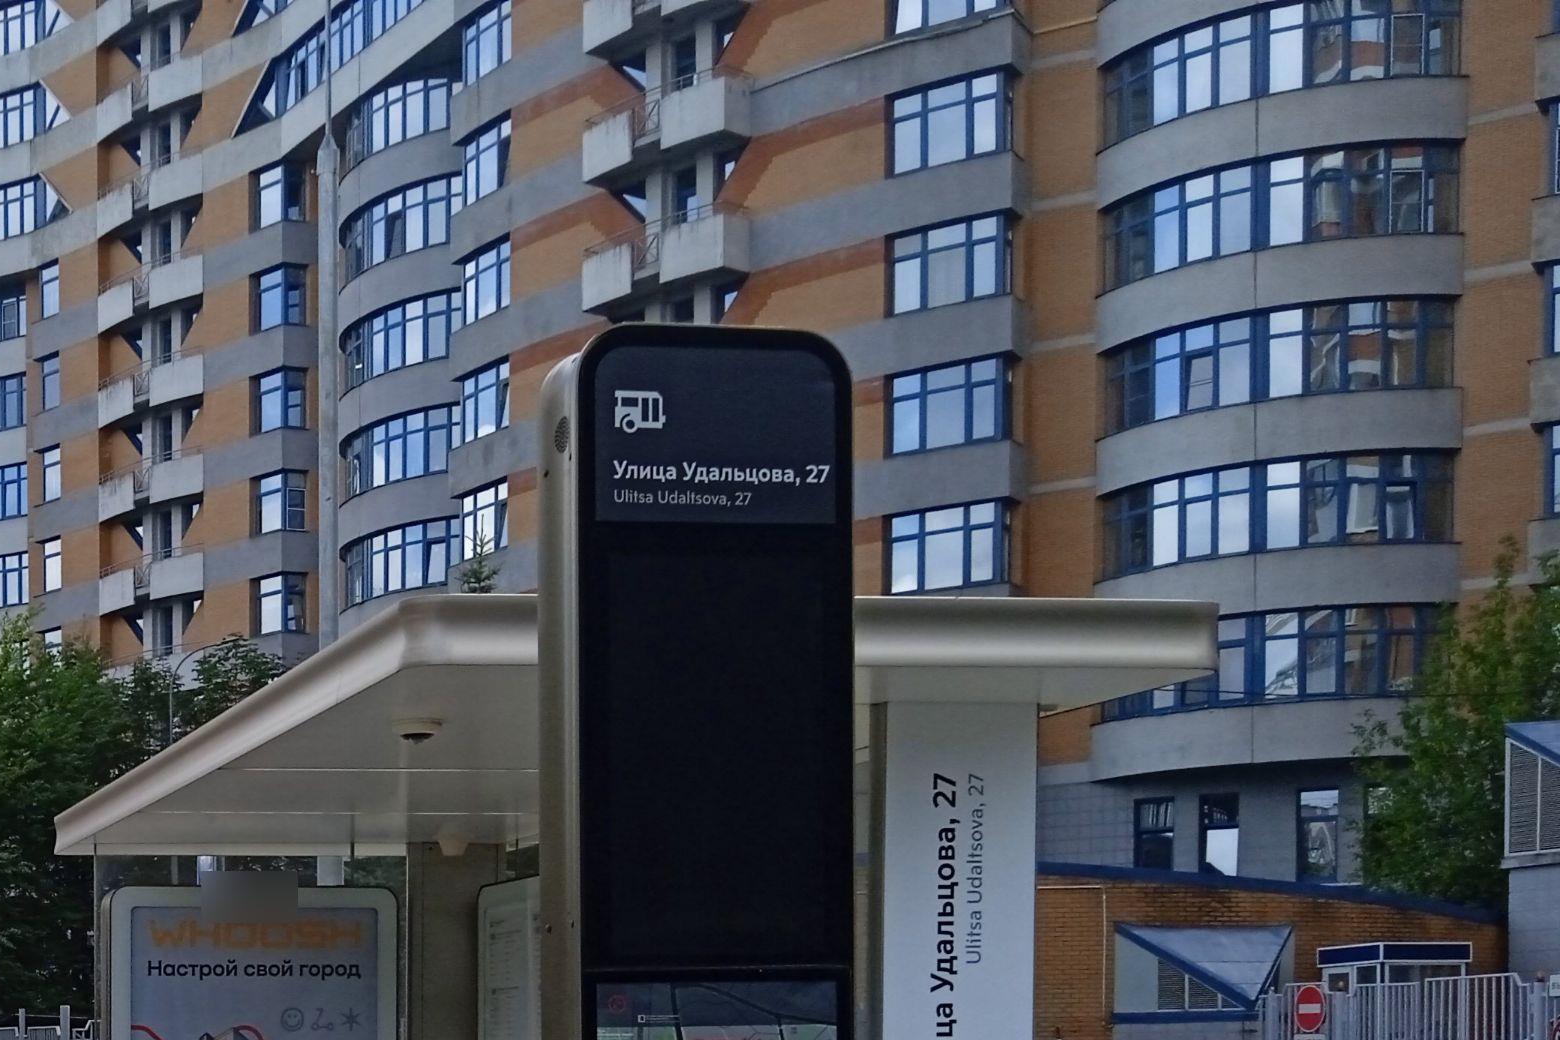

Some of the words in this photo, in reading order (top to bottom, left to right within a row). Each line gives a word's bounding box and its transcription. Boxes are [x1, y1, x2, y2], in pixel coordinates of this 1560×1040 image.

[612, 460, 677, 481] Улица
[682, 461, 801, 486] Удальцова,
[805, 464, 830, 483] 27
[613, 489, 654, 504] Ulitsa
[657, 490, 731, 507] Udaltsova,
[734, 492, 752, 505] 27
[933, 772, 957, 809] 27
[968, 773, 984, 797] 27
[966, 802, 986, 904] Udaltsova,
[930, 818, 960, 992] Удальцова,
[148, 918, 362, 948] WHOOSH
[965, 910, 982, 964] Ulitsa
[147, 960, 238, 980] Настрой
[243, 960, 293, 977] свой
[299, 963, 362, 980] город
